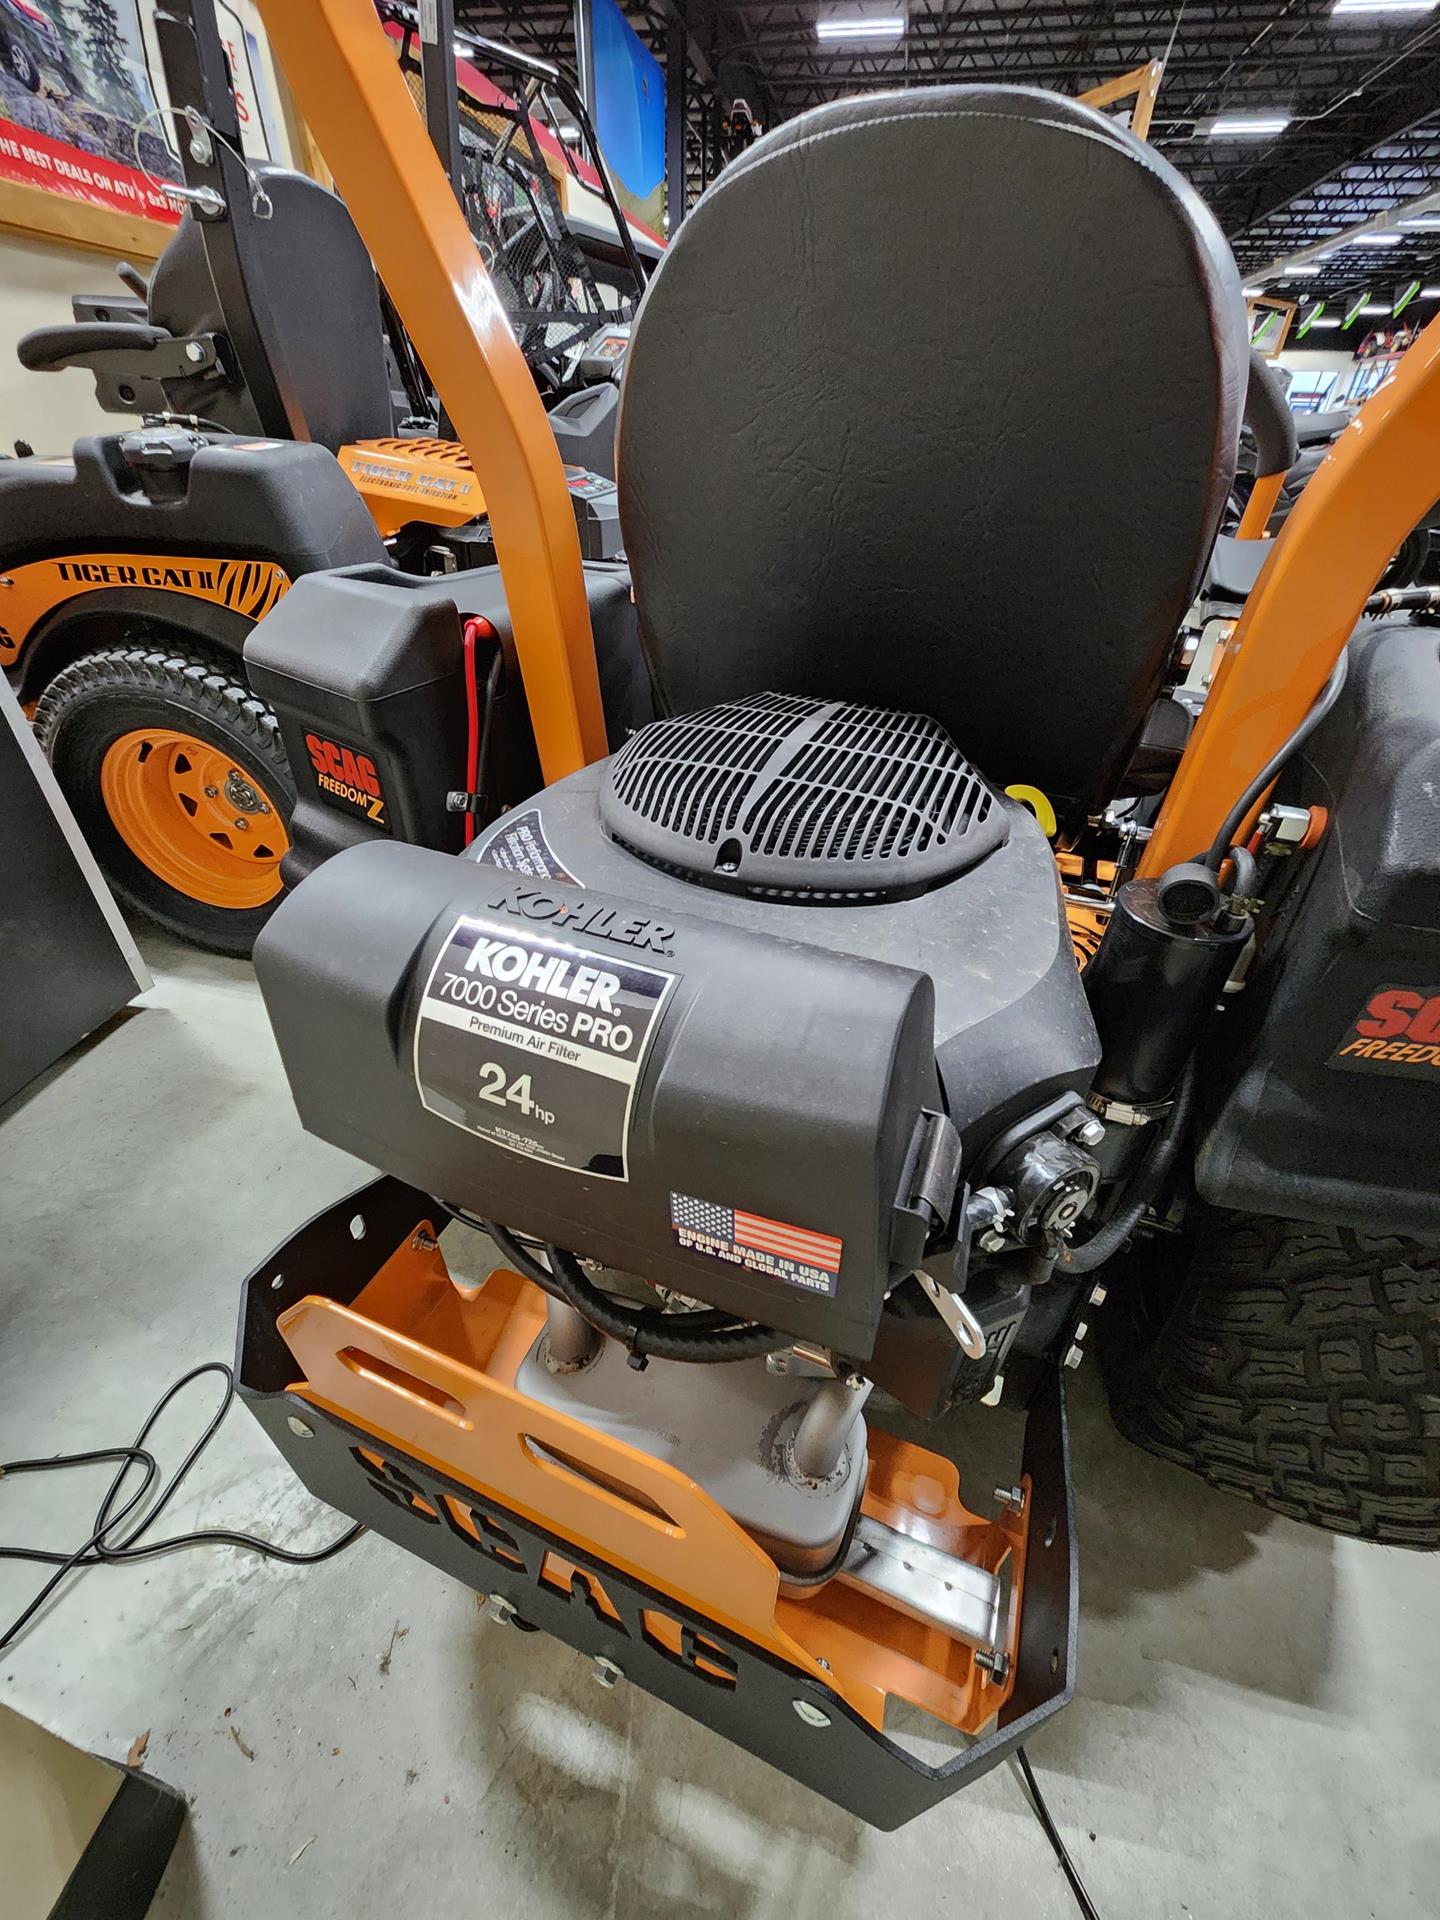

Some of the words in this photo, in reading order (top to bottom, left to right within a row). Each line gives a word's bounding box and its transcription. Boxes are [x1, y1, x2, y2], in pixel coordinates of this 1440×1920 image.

[0, 136, 22, 160] HE
[20, 143, 53, 171] BEST
[53, 157, 95, 186] DEALS
[94, 174, 113, 192] ON
[114, 179, 136, 201] ATV
[351, 460, 413, 482] TIGER
[415, 474, 459, 492] CAT
[51, 562, 138, 585] TIGER
[141, 567, 197, 589] CAT
[197, 570, 216, 590] II
[305, 734, 381, 797] SCAG
[516, 825, 535, 845] PRO
[439, 972, 498, 1010] 7000
[497, 990, 569, 1034] Series
[571, 1011, 634, 1053] PRO
[469, 1016, 524, 1045] Premium
[526, 1034, 547, 1050] Air
[547, 1040, 582, 1062] Filter
[678, 1227, 729, 1251] ENGINE
[732, 1244, 775, 1267] MADE
[778, 1259, 795, 1272] IN
[798, 1265, 831, 1283] USA
[678, 1237, 693, 1248] OF
[695, 1242, 716, 1256] U.S.
[718, 1250, 742, 1265] AND
[744, 1258, 789, 1280] GLOBAL
[790, 1272, 830, 1292] PARTS
[348, 1446, 739, 1692] SCAG
